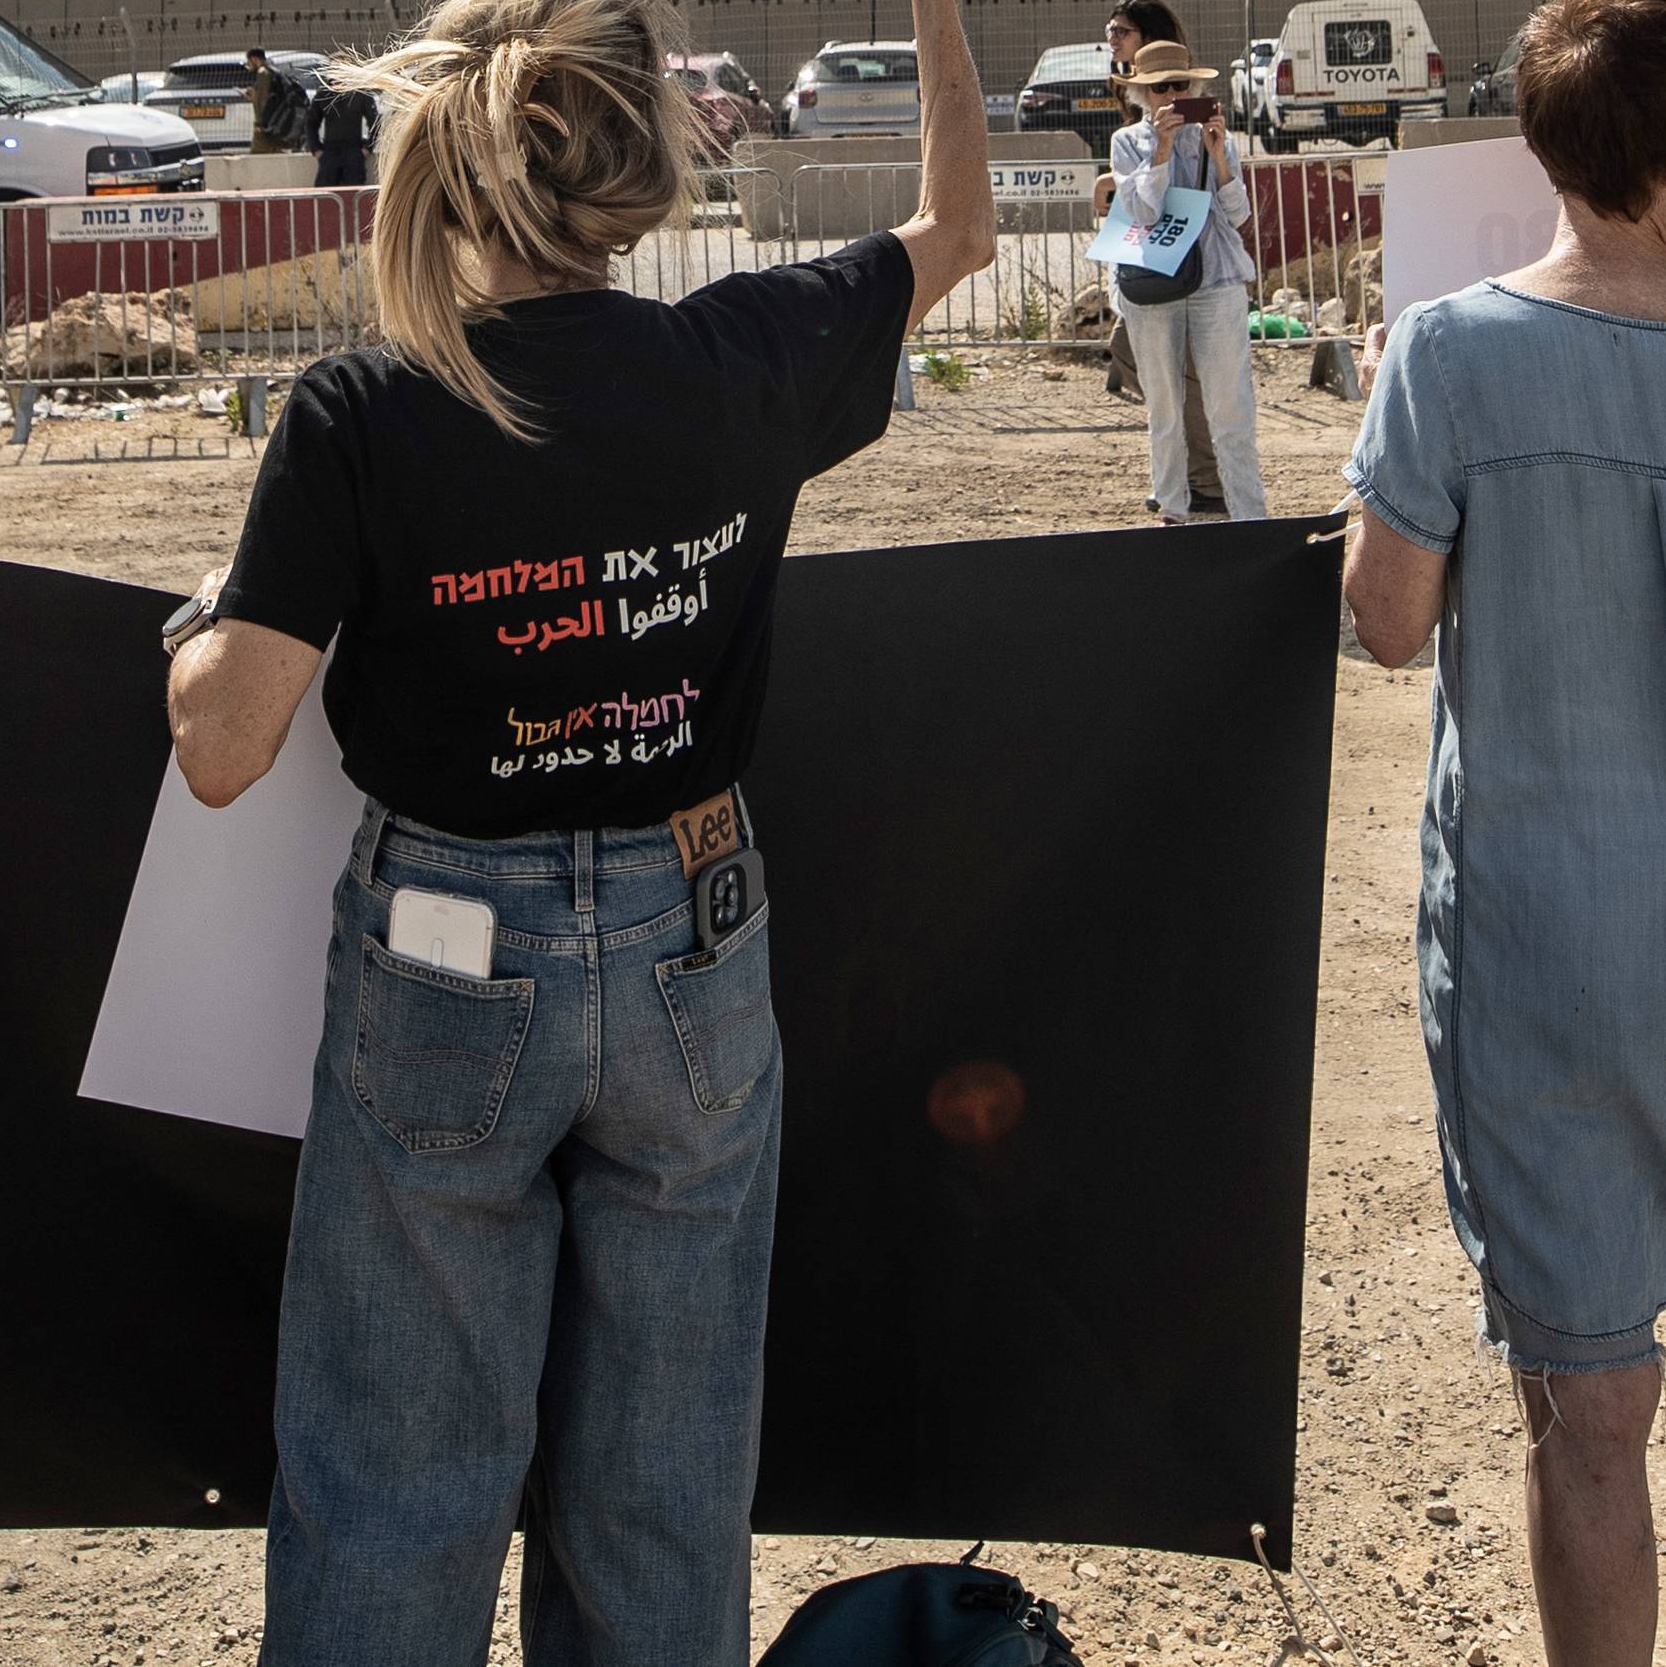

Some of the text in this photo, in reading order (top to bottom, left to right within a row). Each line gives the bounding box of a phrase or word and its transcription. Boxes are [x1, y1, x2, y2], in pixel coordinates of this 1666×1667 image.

[1323, 68, 1400, 83] TOYOTA
[1013, 170, 1056, 188] קשת
[82, 206, 185, 225] קשת במות
[1159, 217, 1189, 247] 180
[431, 512, 747, 606] לעצור את המלחמה
[497, 567, 708, 655] أوقفوا الحرب
[507, 678, 700, 746] לחמלה אין גבול
[532, 746, 594, 773] حدود
[603, 739, 622, 765] لا
[491, 754, 525, 779] لها
[679, 805, 732, 862] Lee
